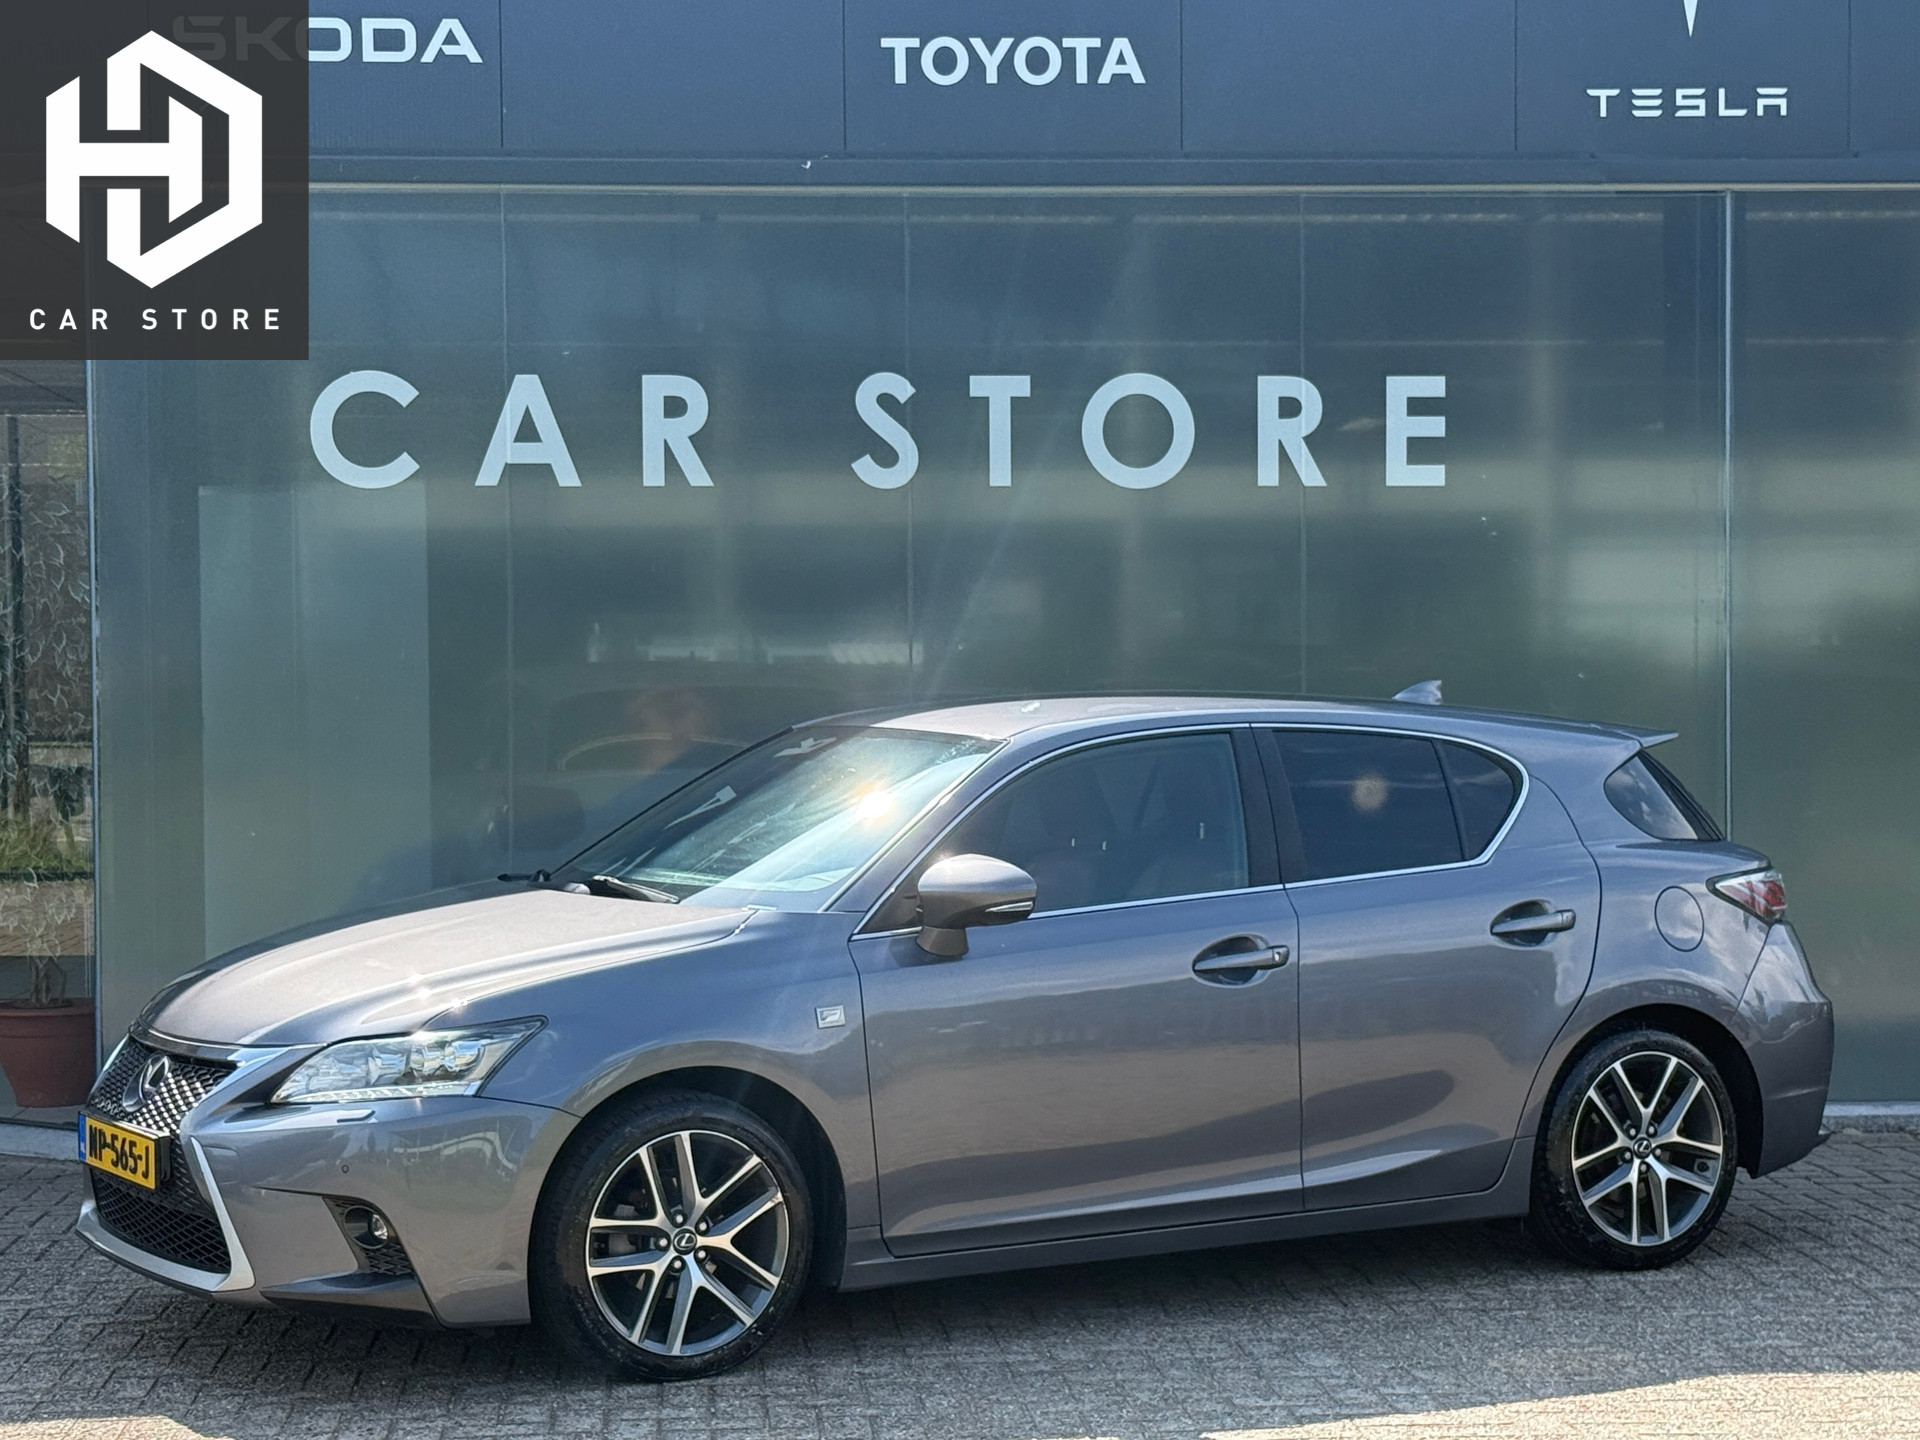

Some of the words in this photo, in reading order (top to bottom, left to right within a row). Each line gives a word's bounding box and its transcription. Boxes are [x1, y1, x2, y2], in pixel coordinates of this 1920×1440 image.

[880, 36, 1146, 86] TOYOTA
[1586, 87, 1788, 118] TESLA
[309, 369, 714, 490] CAR
[851, 371, 1447, 490] STORE
[89, 1125, 149, 1179] NP-565-J
